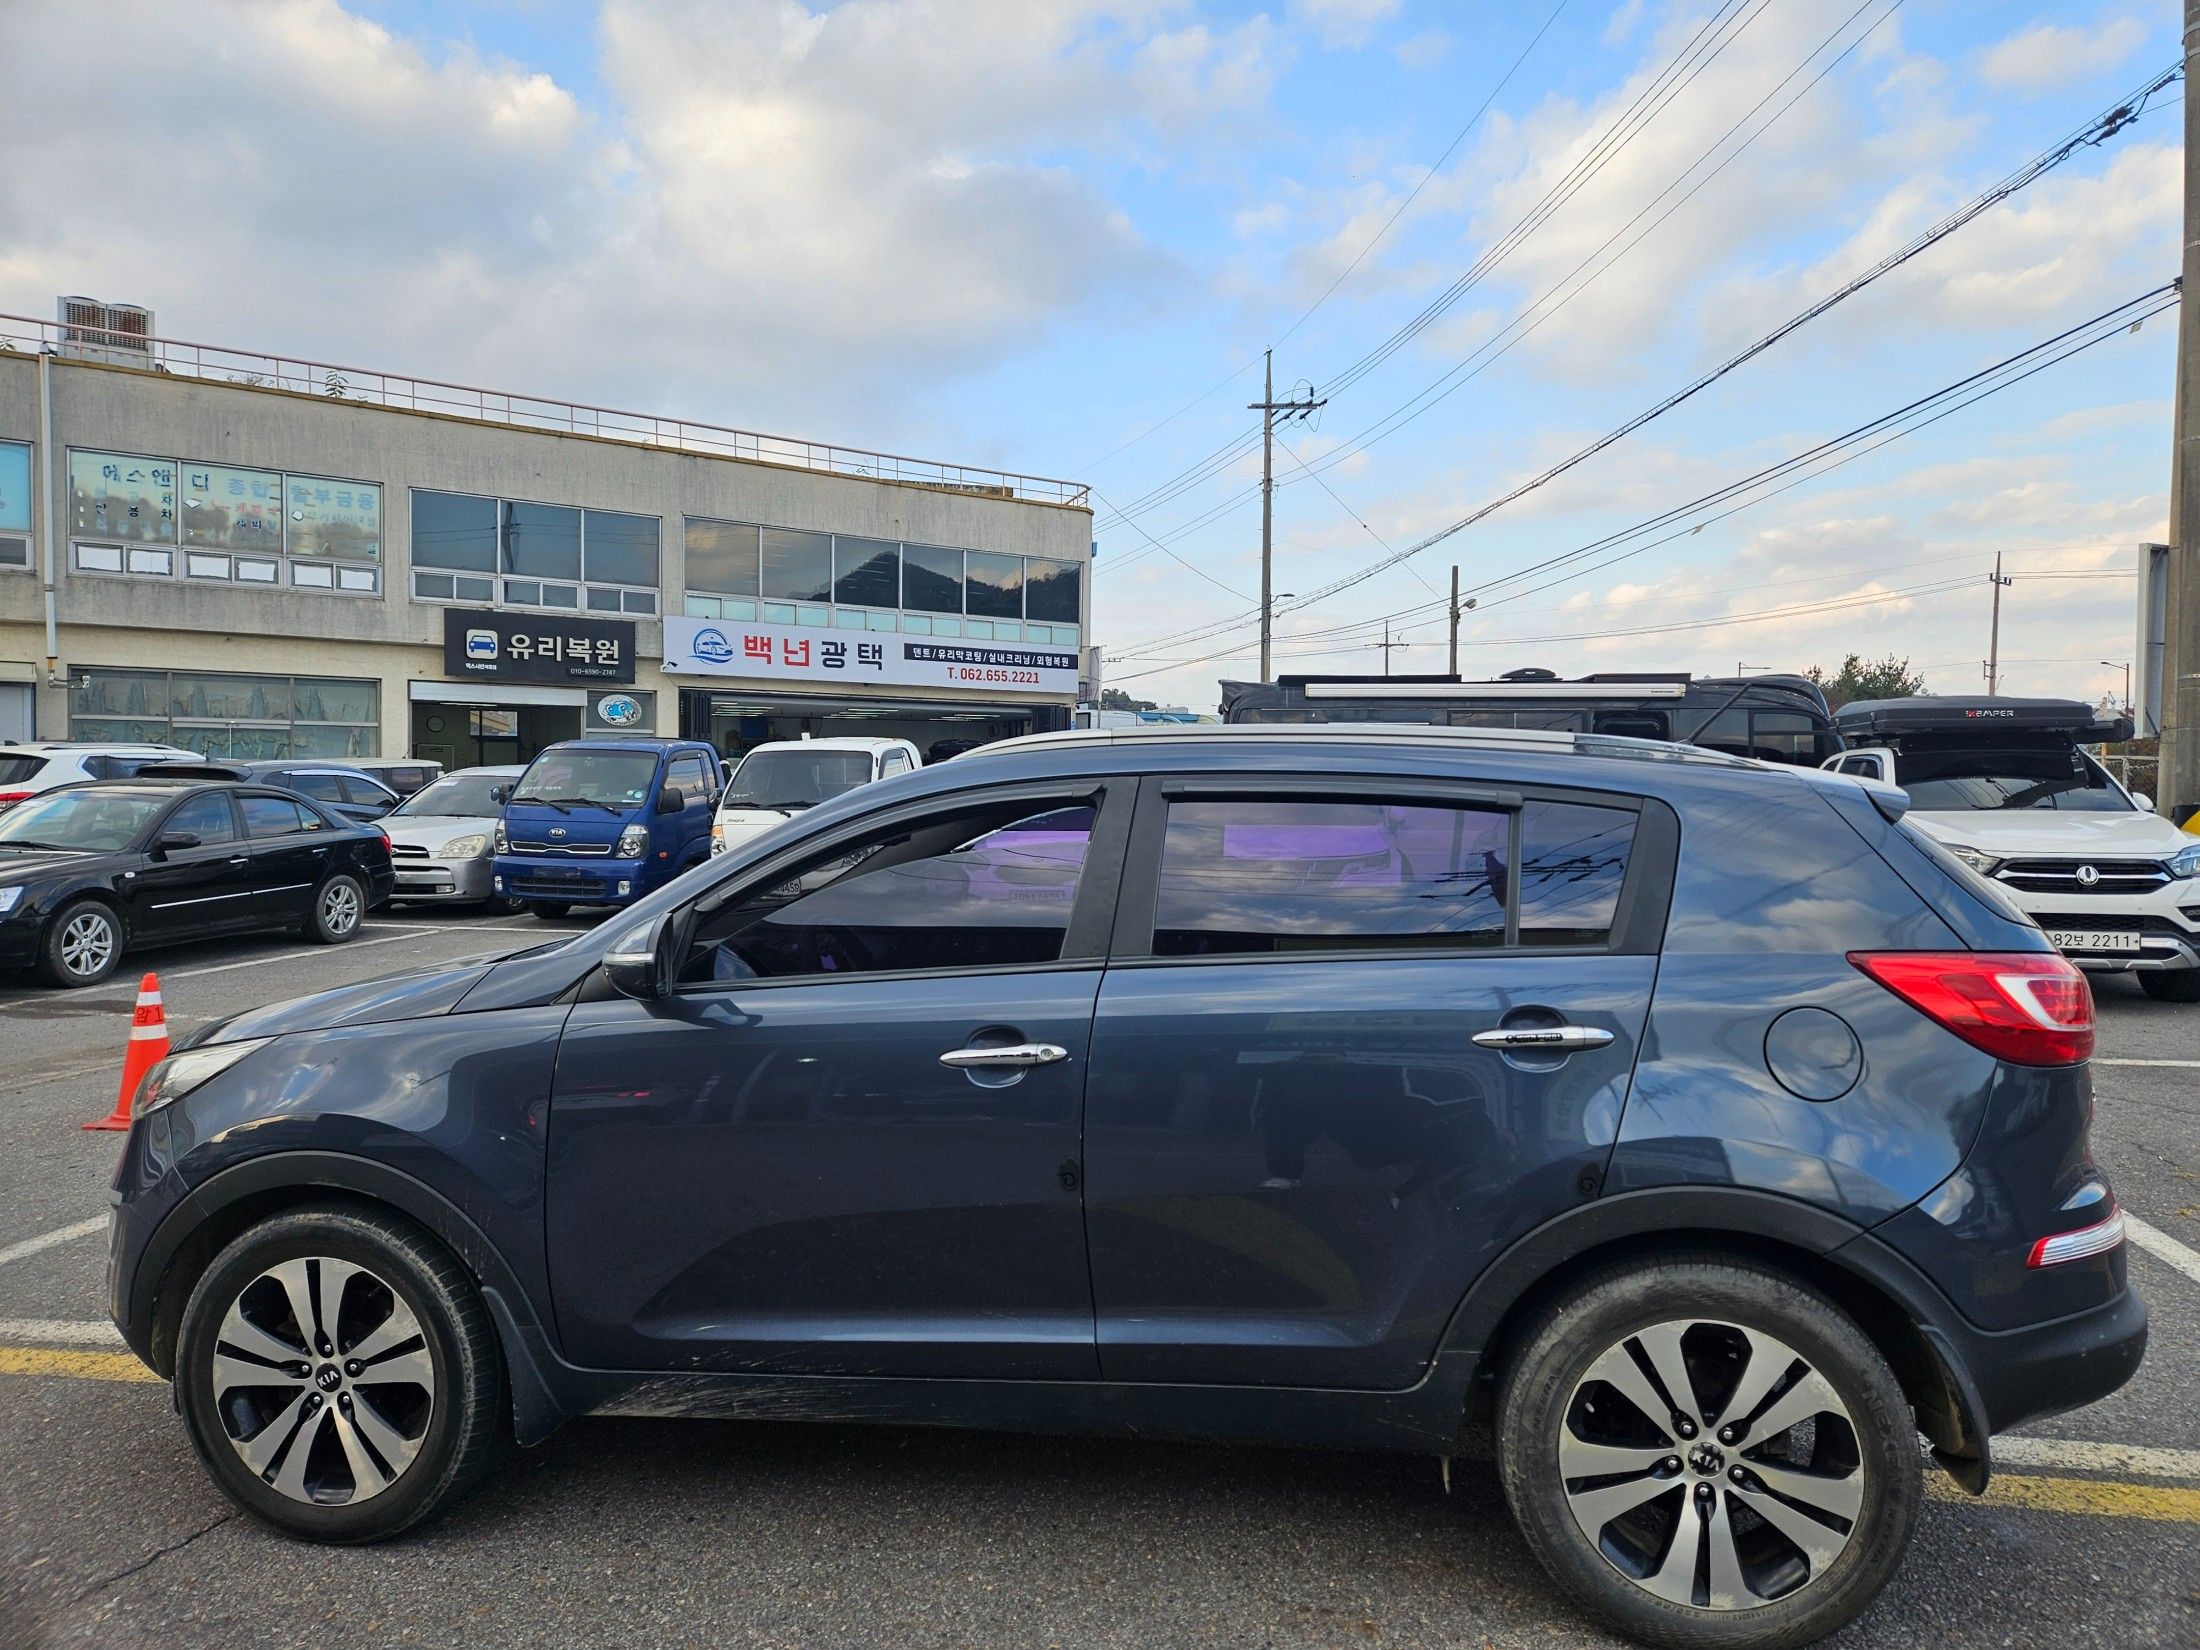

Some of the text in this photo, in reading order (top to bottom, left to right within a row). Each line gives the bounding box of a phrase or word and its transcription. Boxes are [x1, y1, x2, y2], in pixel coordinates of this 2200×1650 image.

[507, 634, 619, 665] 유리복원
[960, 667, 1040, 684] 062.655.2221
[2053, 933, 2130, 948] 82보 2211
[317, 1370, 339, 1387] KIA
[1691, 1449, 1719, 1471] KIA
